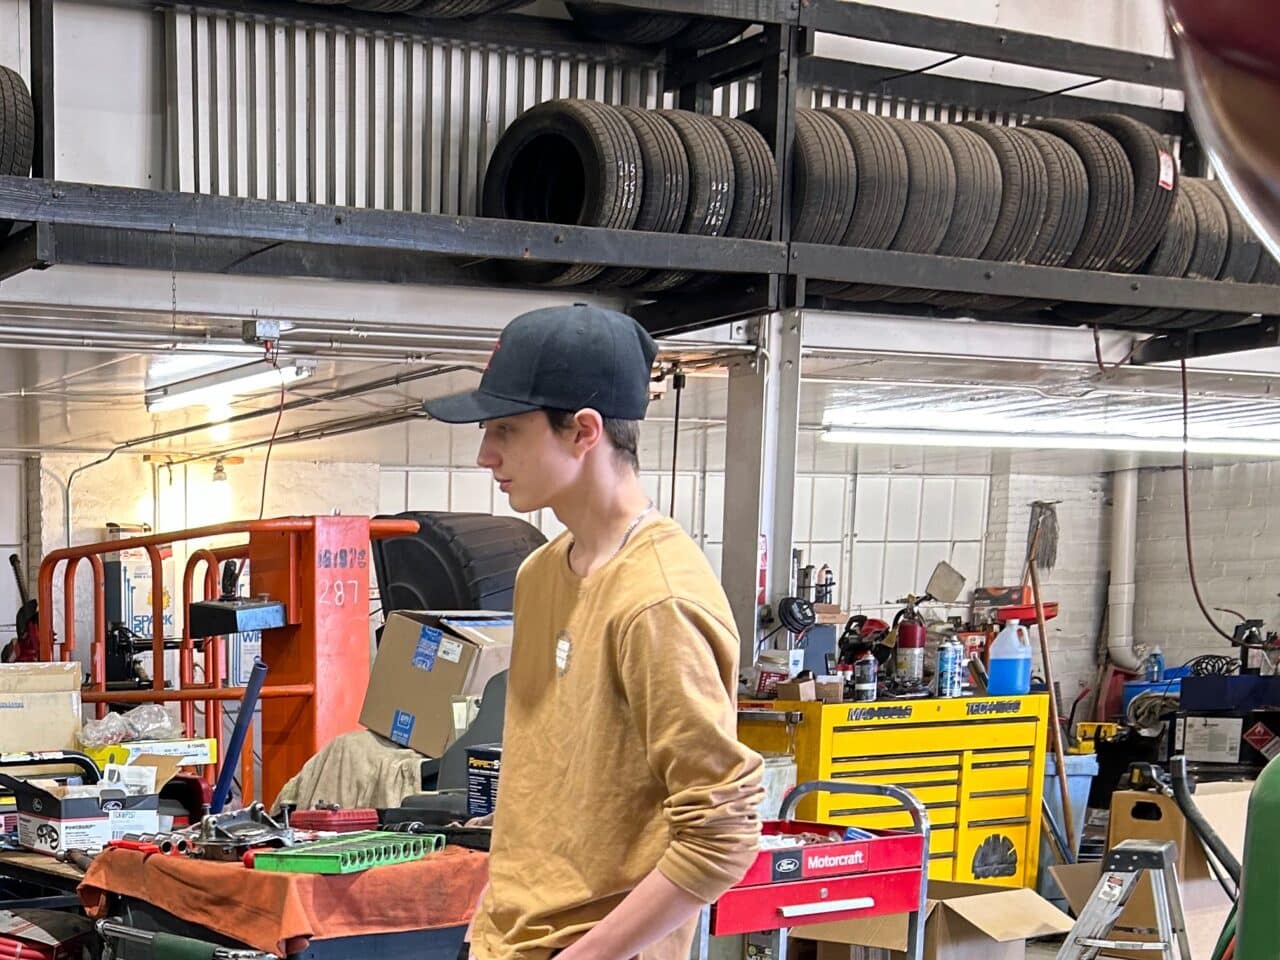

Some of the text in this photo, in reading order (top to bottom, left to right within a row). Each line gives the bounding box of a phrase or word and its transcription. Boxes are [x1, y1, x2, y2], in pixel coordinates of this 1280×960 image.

[618, 161, 635, 176] 215
[319, 579, 358, 606] 287
[134, 615, 173, 625] SPAK
[807, 850, 864, 870] Motorcraft
